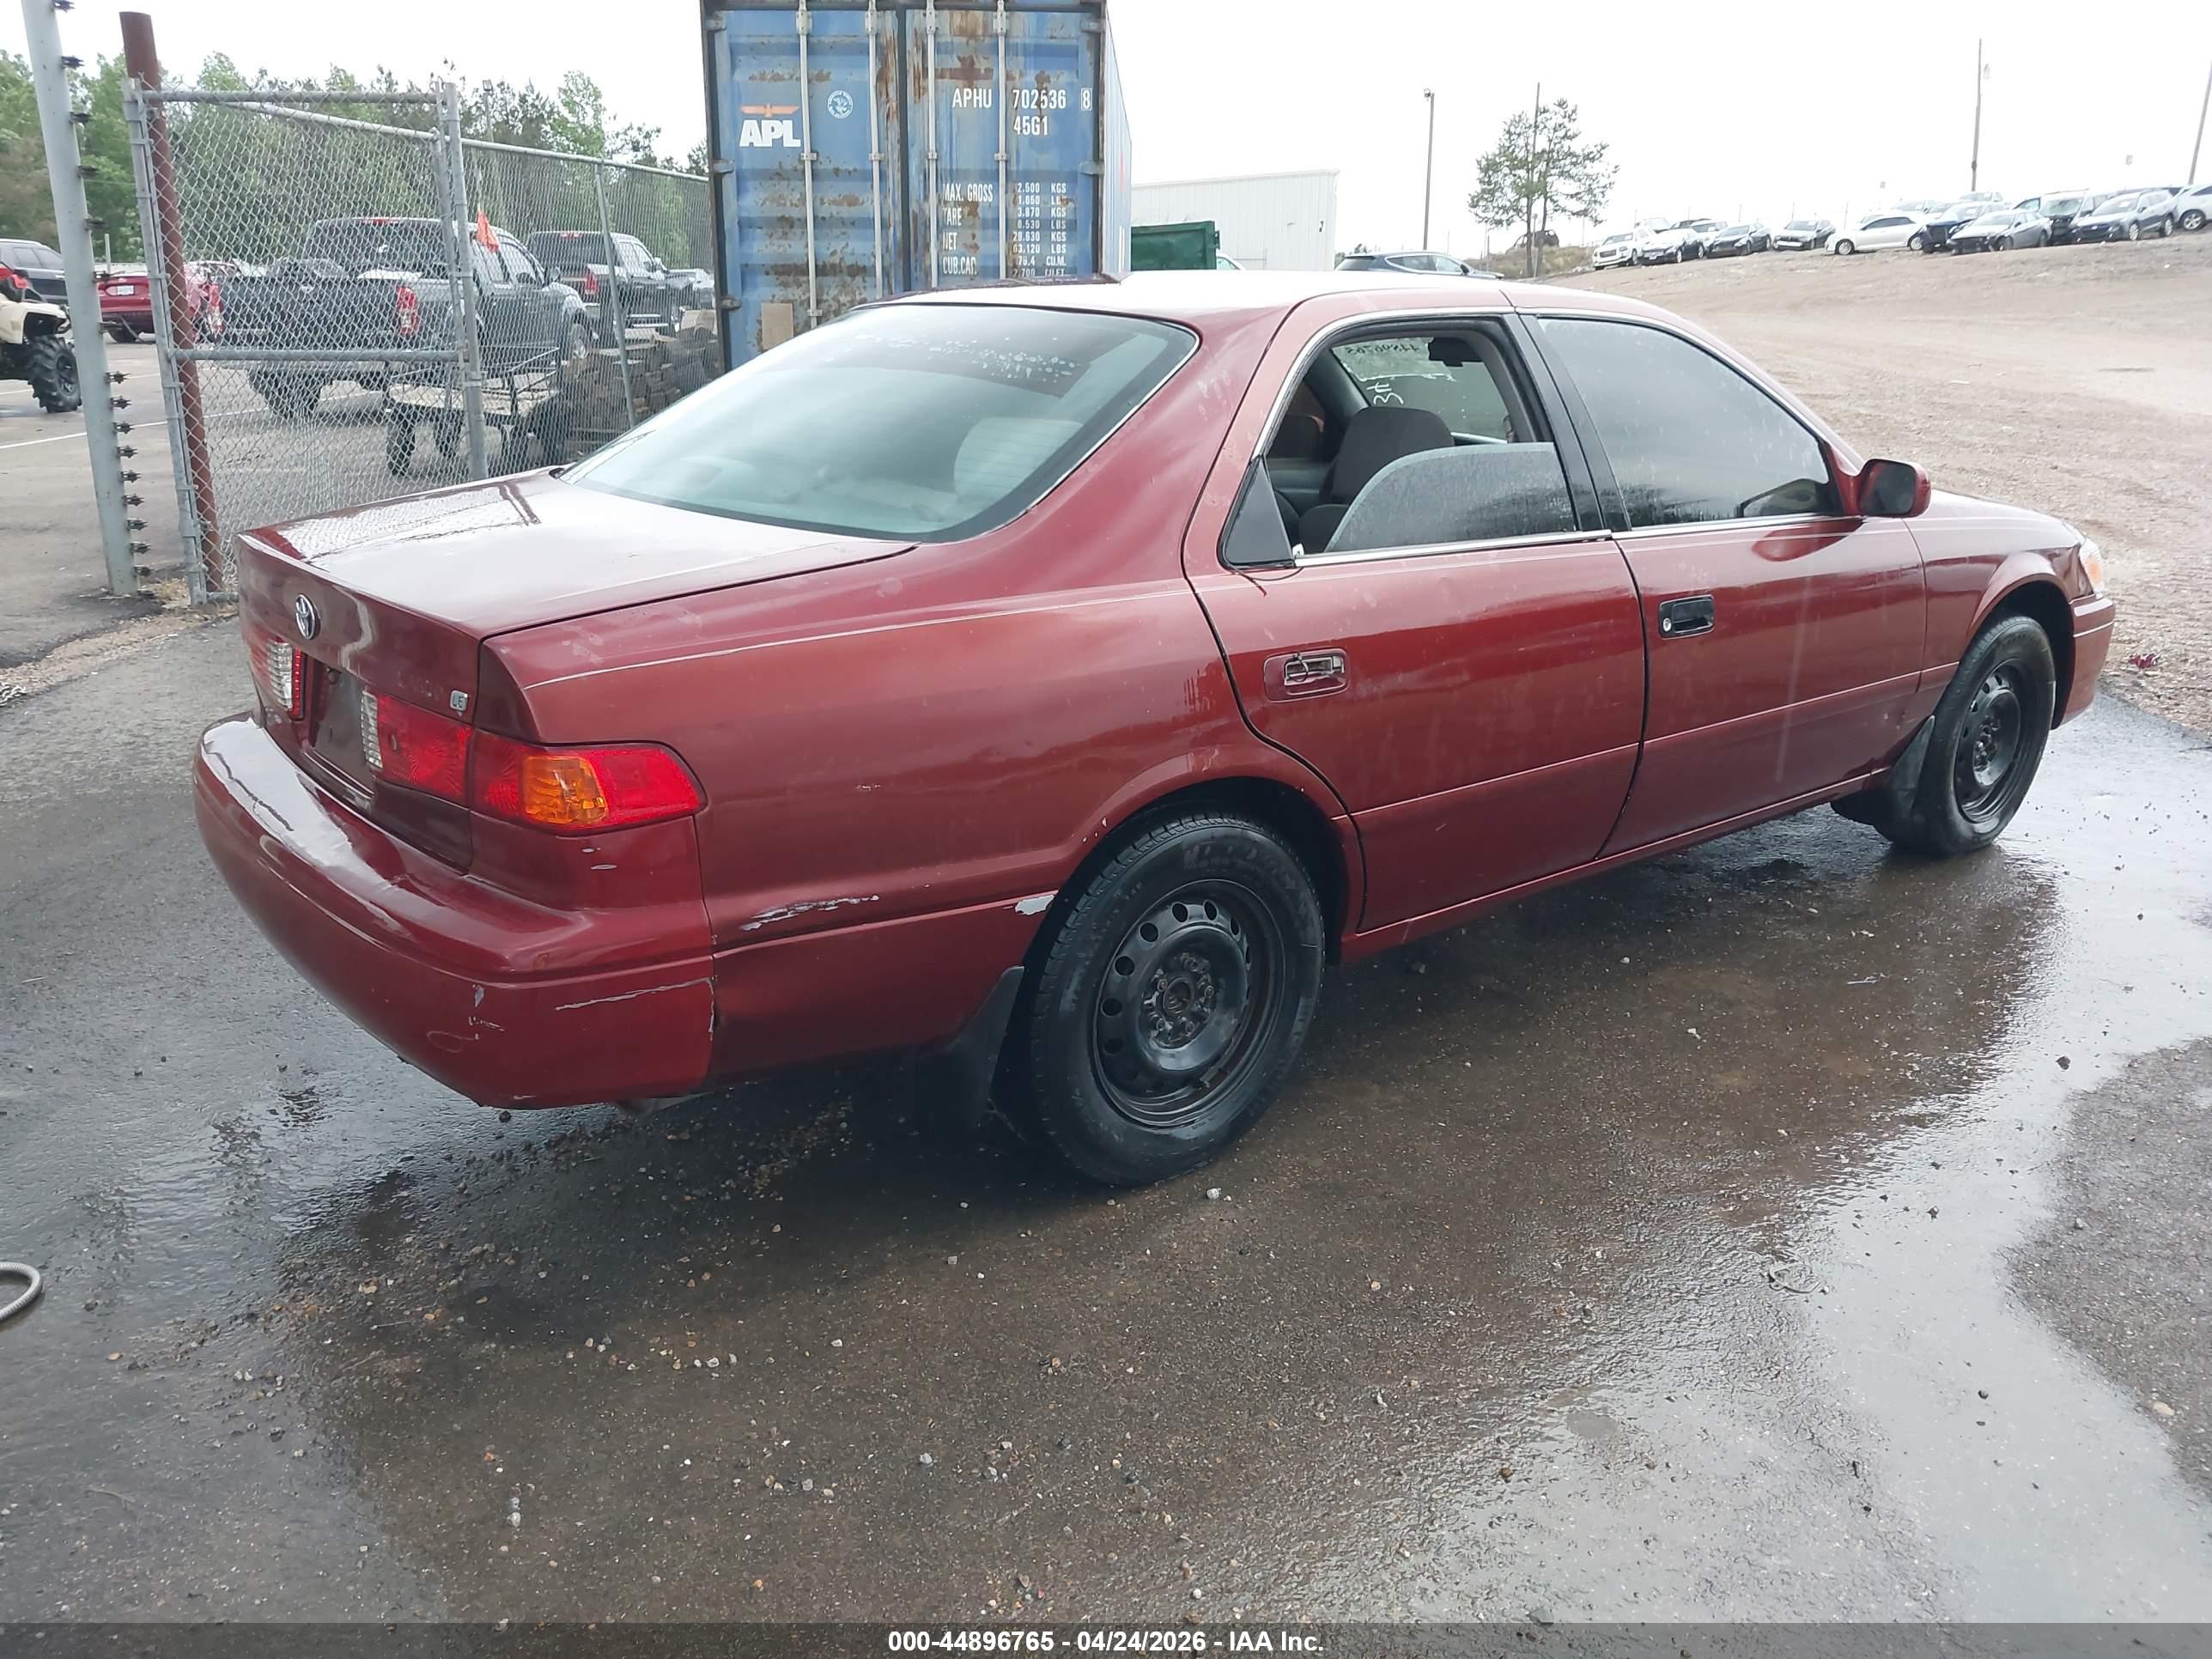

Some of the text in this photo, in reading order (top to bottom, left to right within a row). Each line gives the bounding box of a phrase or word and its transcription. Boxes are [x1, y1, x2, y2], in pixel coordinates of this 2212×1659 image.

[952, 88, 1091, 110] APHU 702536 8
[738, 119, 801, 148] APL
[1013, 115, 1048, 137] 45G1
[942, 183, 964, 203] MAX.
[967, 183, 994, 203] GROSS
[1050, 182, 1066, 194] KGS
[942, 208, 963, 227] TARE
[1050, 206, 1066, 217] KGS
[942, 231, 958, 251] NET
[1050, 231, 1066, 241] KGS
[1050, 243, 1066, 254] LBS
